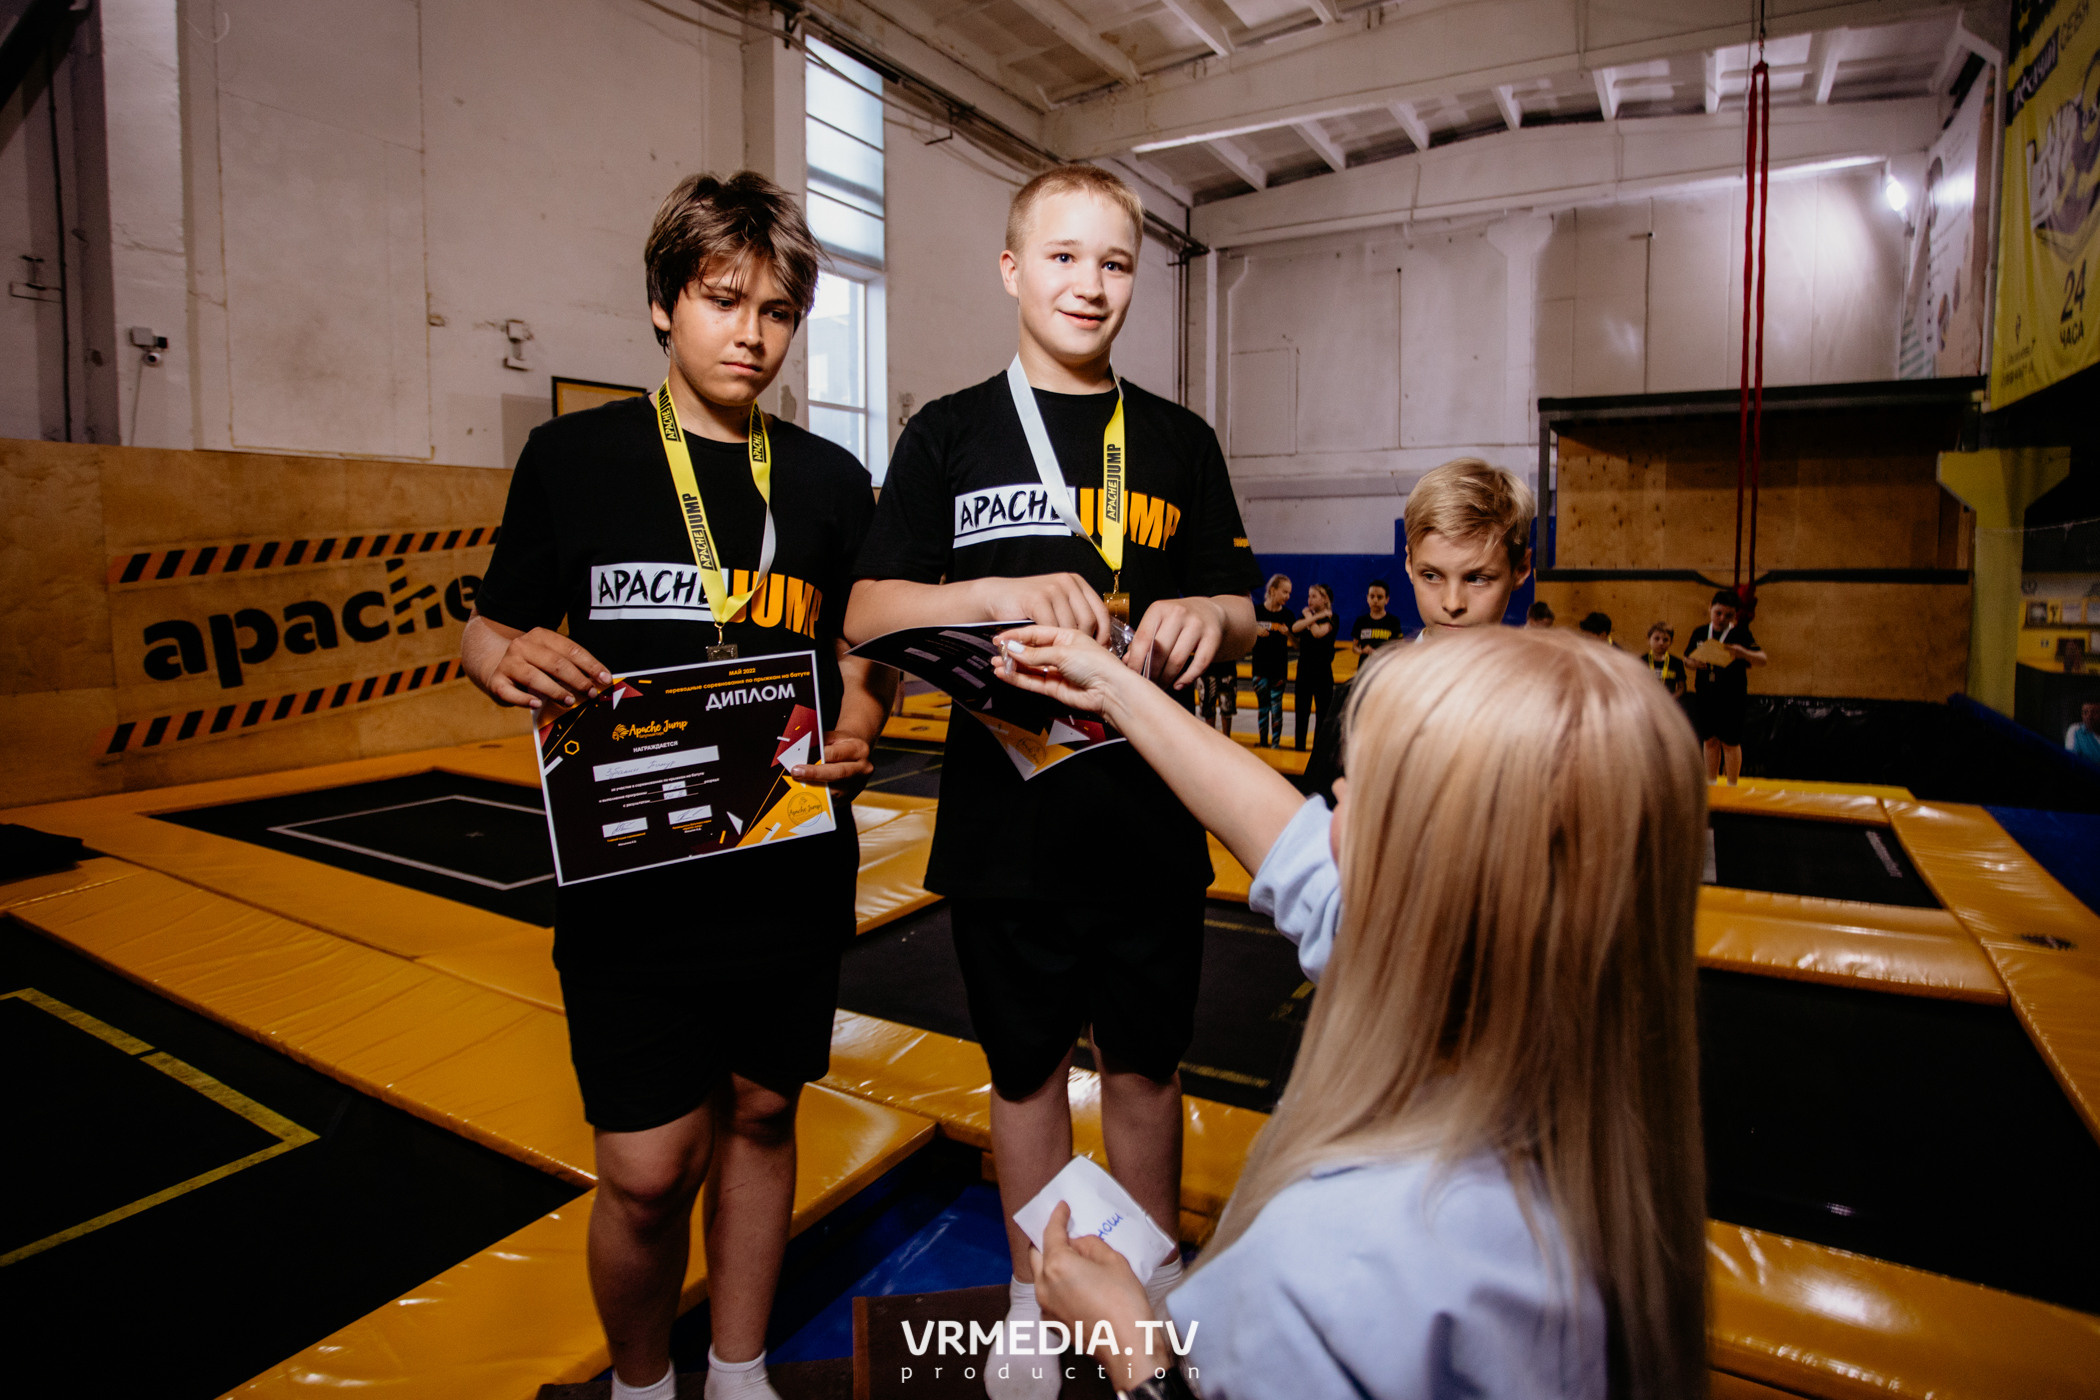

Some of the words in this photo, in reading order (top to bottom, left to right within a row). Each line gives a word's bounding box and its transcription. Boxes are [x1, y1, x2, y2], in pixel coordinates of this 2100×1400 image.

[2060, 259, 2086, 323] 24
[2060, 319, 2084, 350] ЧАСА
[661, 408, 678, 440] APACHE
[752, 432, 763, 461] APACHE
[1107, 443, 1121, 480] JUMP
[682, 493, 705, 532] JUMP
[1107, 480, 1118, 521] APACHE
[693, 530, 714, 570] APACHE
[143, 558, 483, 689] apache
[729, 668, 742, 676] МАЙ
[705, 683, 796, 711] ДИПЛОМ
[628, 720, 662, 738] Apache
[663, 719, 688, 732] Jump
[633, 740, 678, 752] НАГРАЖДАЕТСЯ
